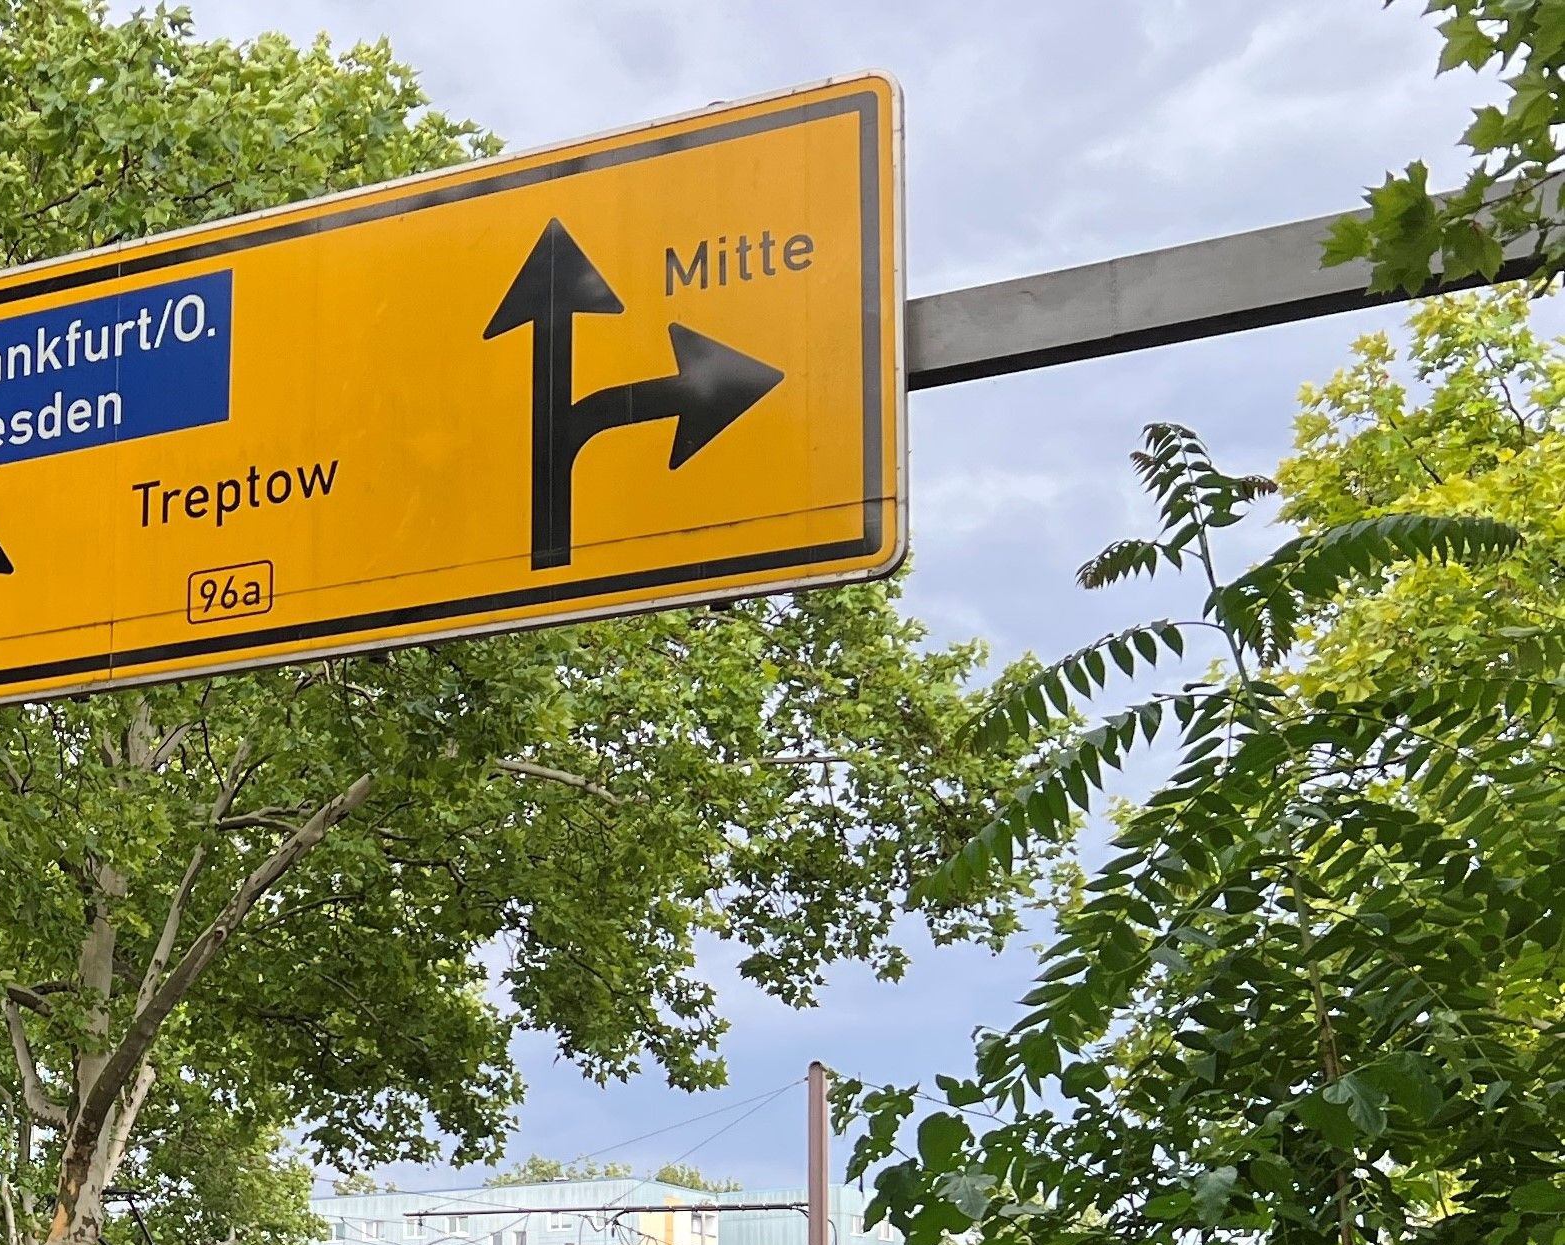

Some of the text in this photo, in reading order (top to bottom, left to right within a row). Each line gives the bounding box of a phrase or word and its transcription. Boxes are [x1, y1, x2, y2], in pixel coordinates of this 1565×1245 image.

[666, 231, 814, 296] Mitte
[132, 460, 339, 527] Treptow
[199, 576, 261, 614] 96a
